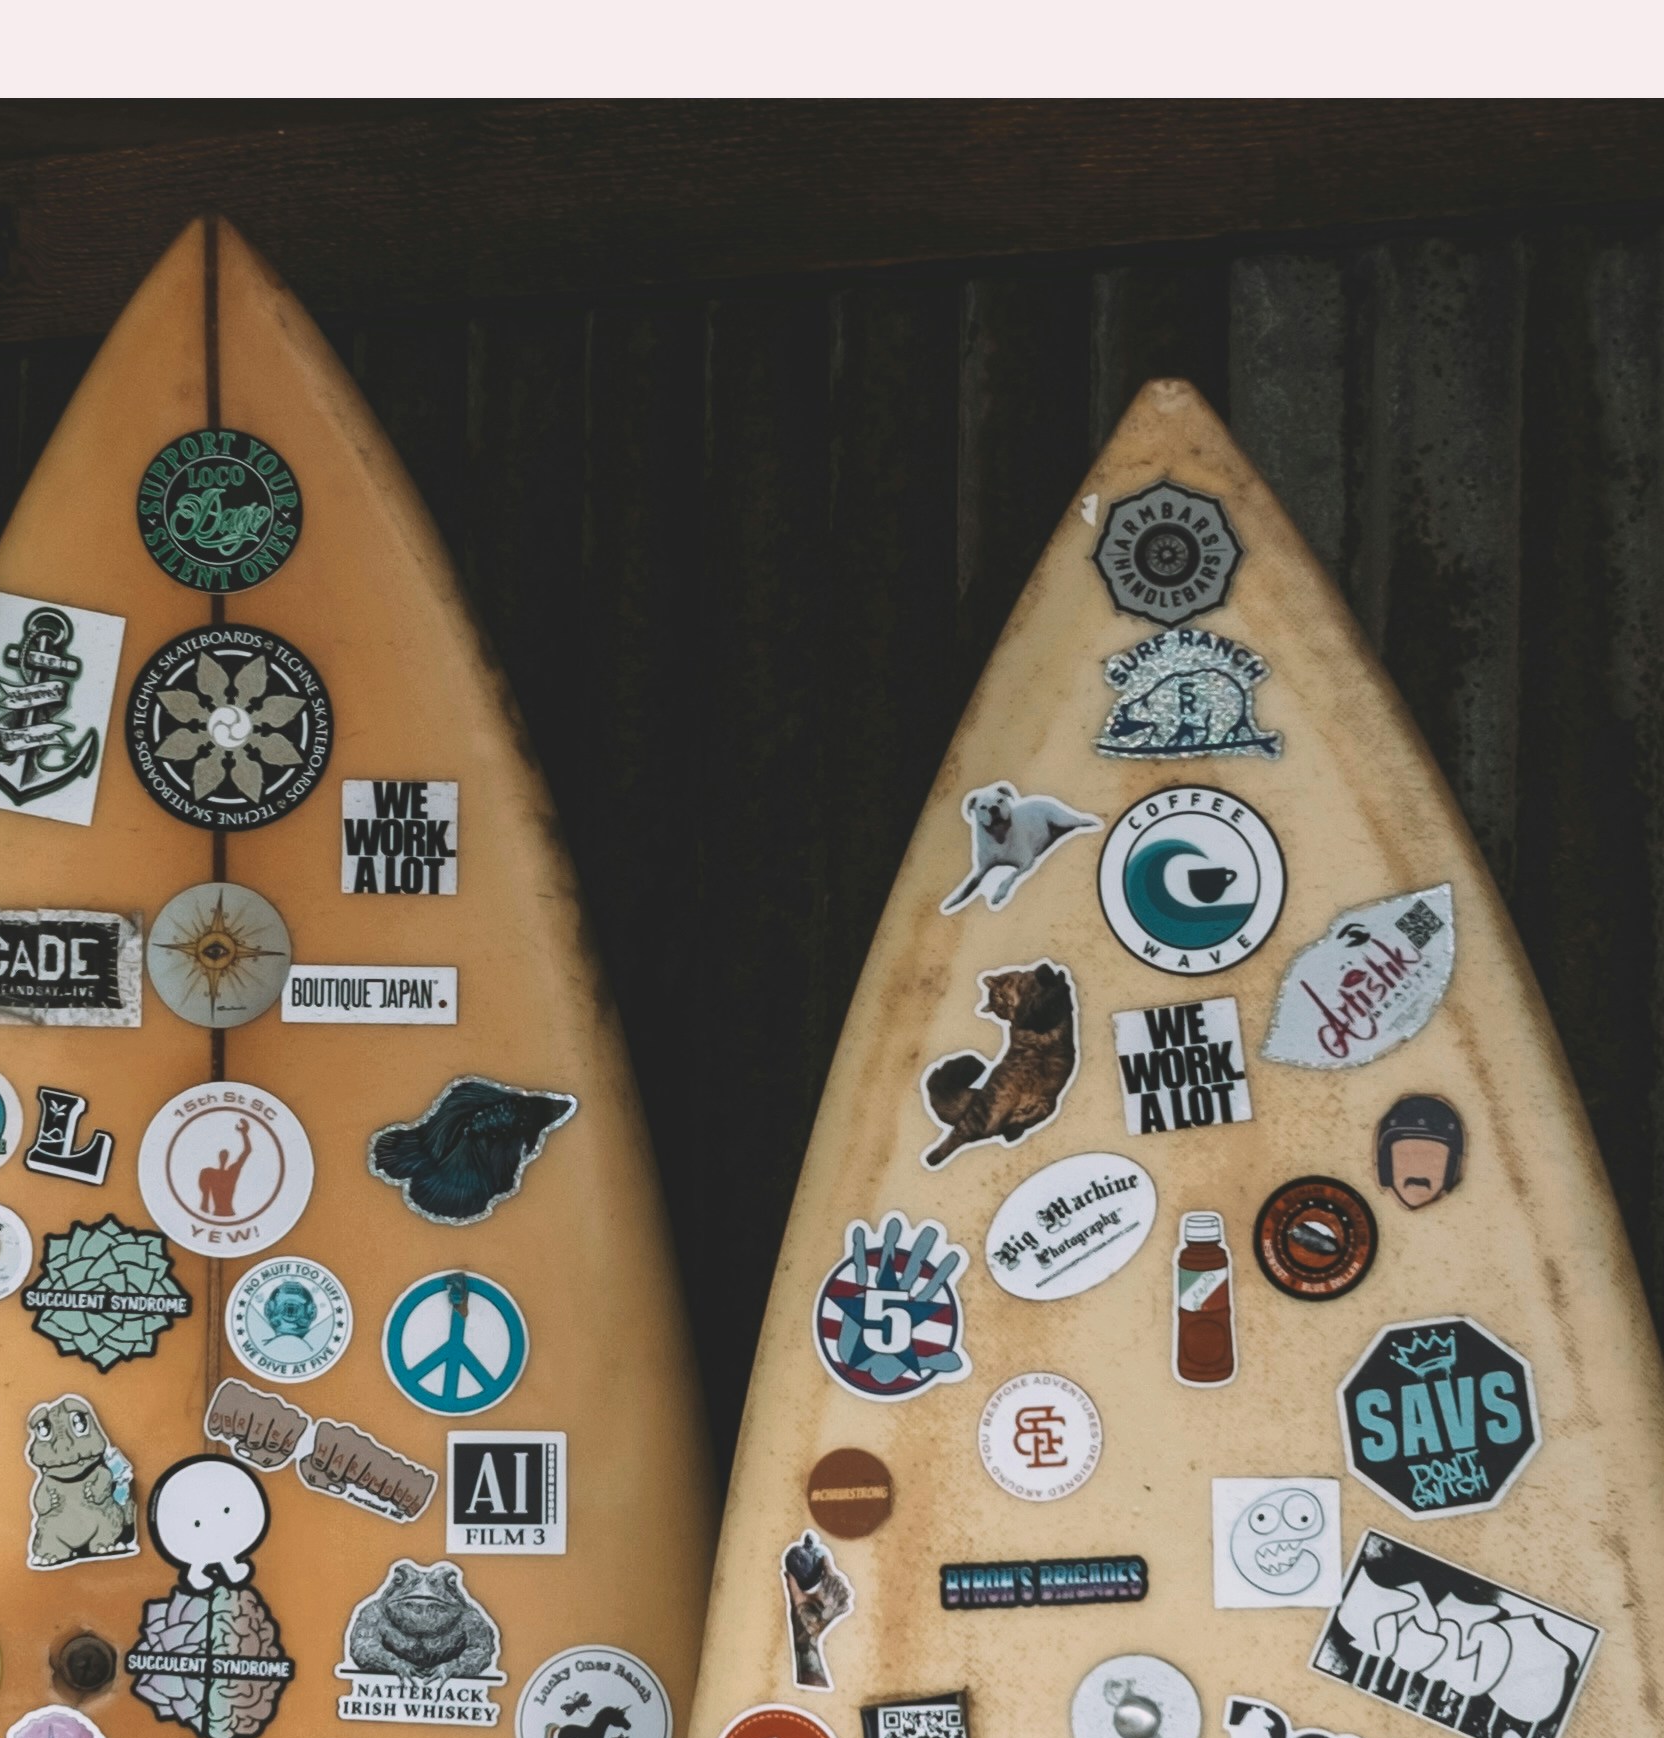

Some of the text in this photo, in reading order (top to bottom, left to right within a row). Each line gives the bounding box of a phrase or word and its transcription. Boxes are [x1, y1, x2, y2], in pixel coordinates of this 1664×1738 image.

[139, 432, 298, 515] SUPPORT YOUR
[186, 465, 245, 488] LOCO
[1117, 502, 1219, 553] ARMBARS
[1114, 553, 1222, 608] HANDLEBARS
[1110, 629, 1266, 687] SURF RANCH
[374, 782, 428, 819] WE
[355, 857, 446, 895] A LOT
[1142, 932, 1254, 968] WAVE
[174, 1093, 219, 1118] 15th
[223, 1092, 245, 1105] St
[190, 1225, 261, 1244] YEW!
[243, 1263, 341, 1303] NO MUFF TOO TUFF
[26, 1291, 188, 1313] SUCCULENT SYNDROME
[242, 1339, 335, 1375] WE DIVE AT FIVE
[465, 1452, 530, 1514] AI
[465, 1528, 546, 1546] FILM 3
[356, 1682, 484, 1703] NATTERJACK
[534, 1659, 652, 1705] Lucky Ones Ranch
[343, 1702, 497, 1722] IRISH WHISKEY
